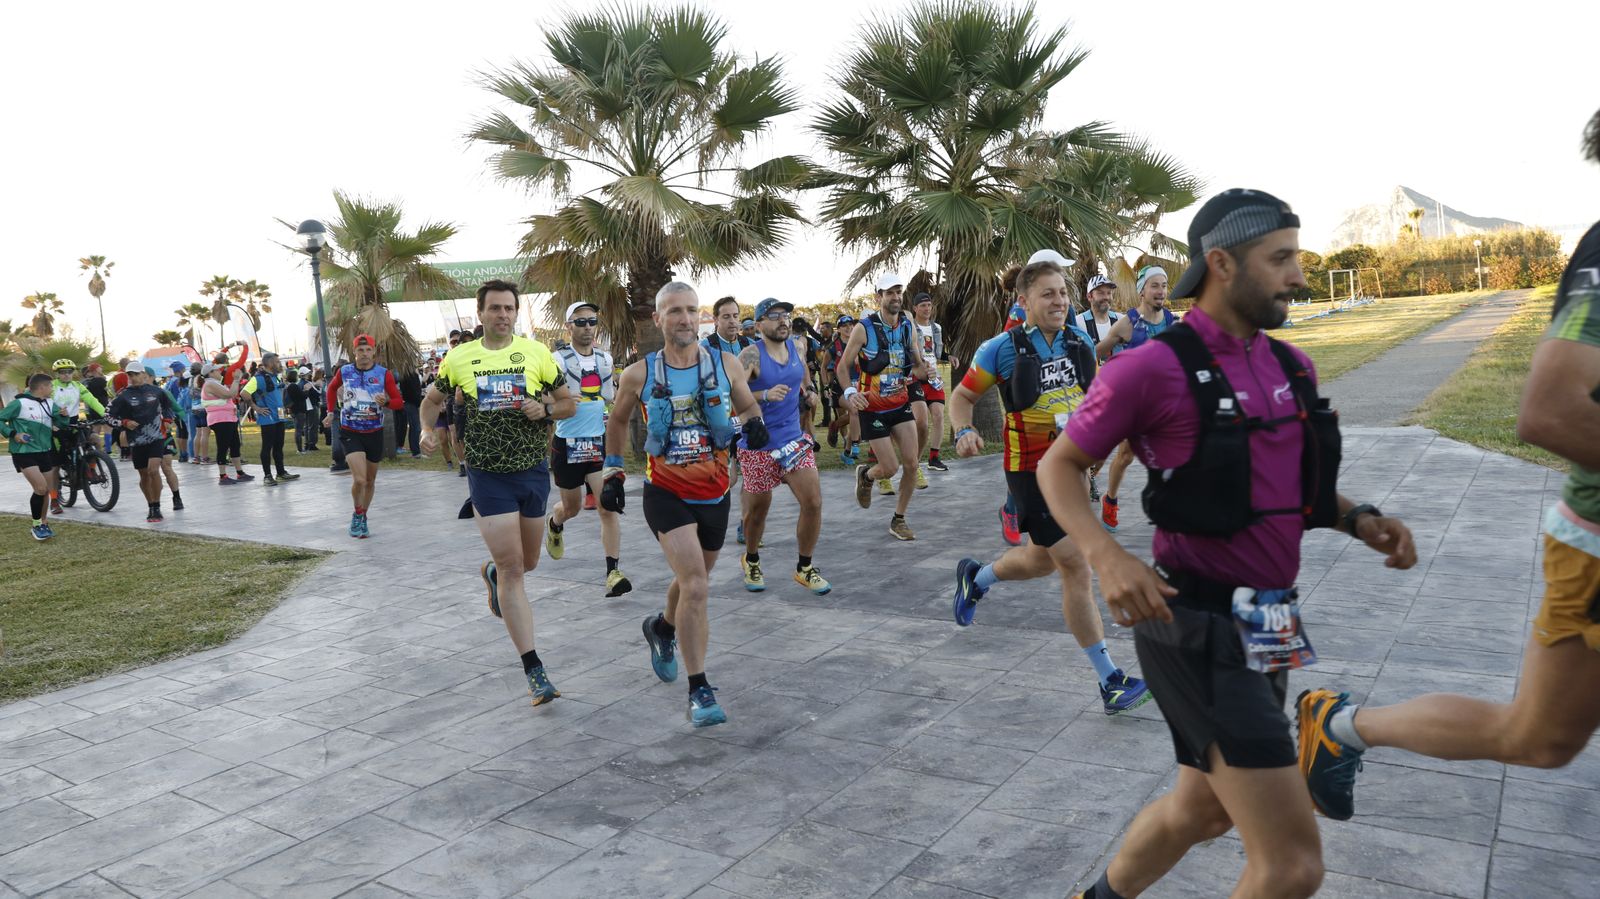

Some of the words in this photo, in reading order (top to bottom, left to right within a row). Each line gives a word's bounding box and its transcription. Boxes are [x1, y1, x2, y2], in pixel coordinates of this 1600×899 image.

[490, 380, 513, 394] 146
[678, 429, 700, 445] 193
[576, 441, 593, 451] 204
[781, 440, 800, 456] 209
